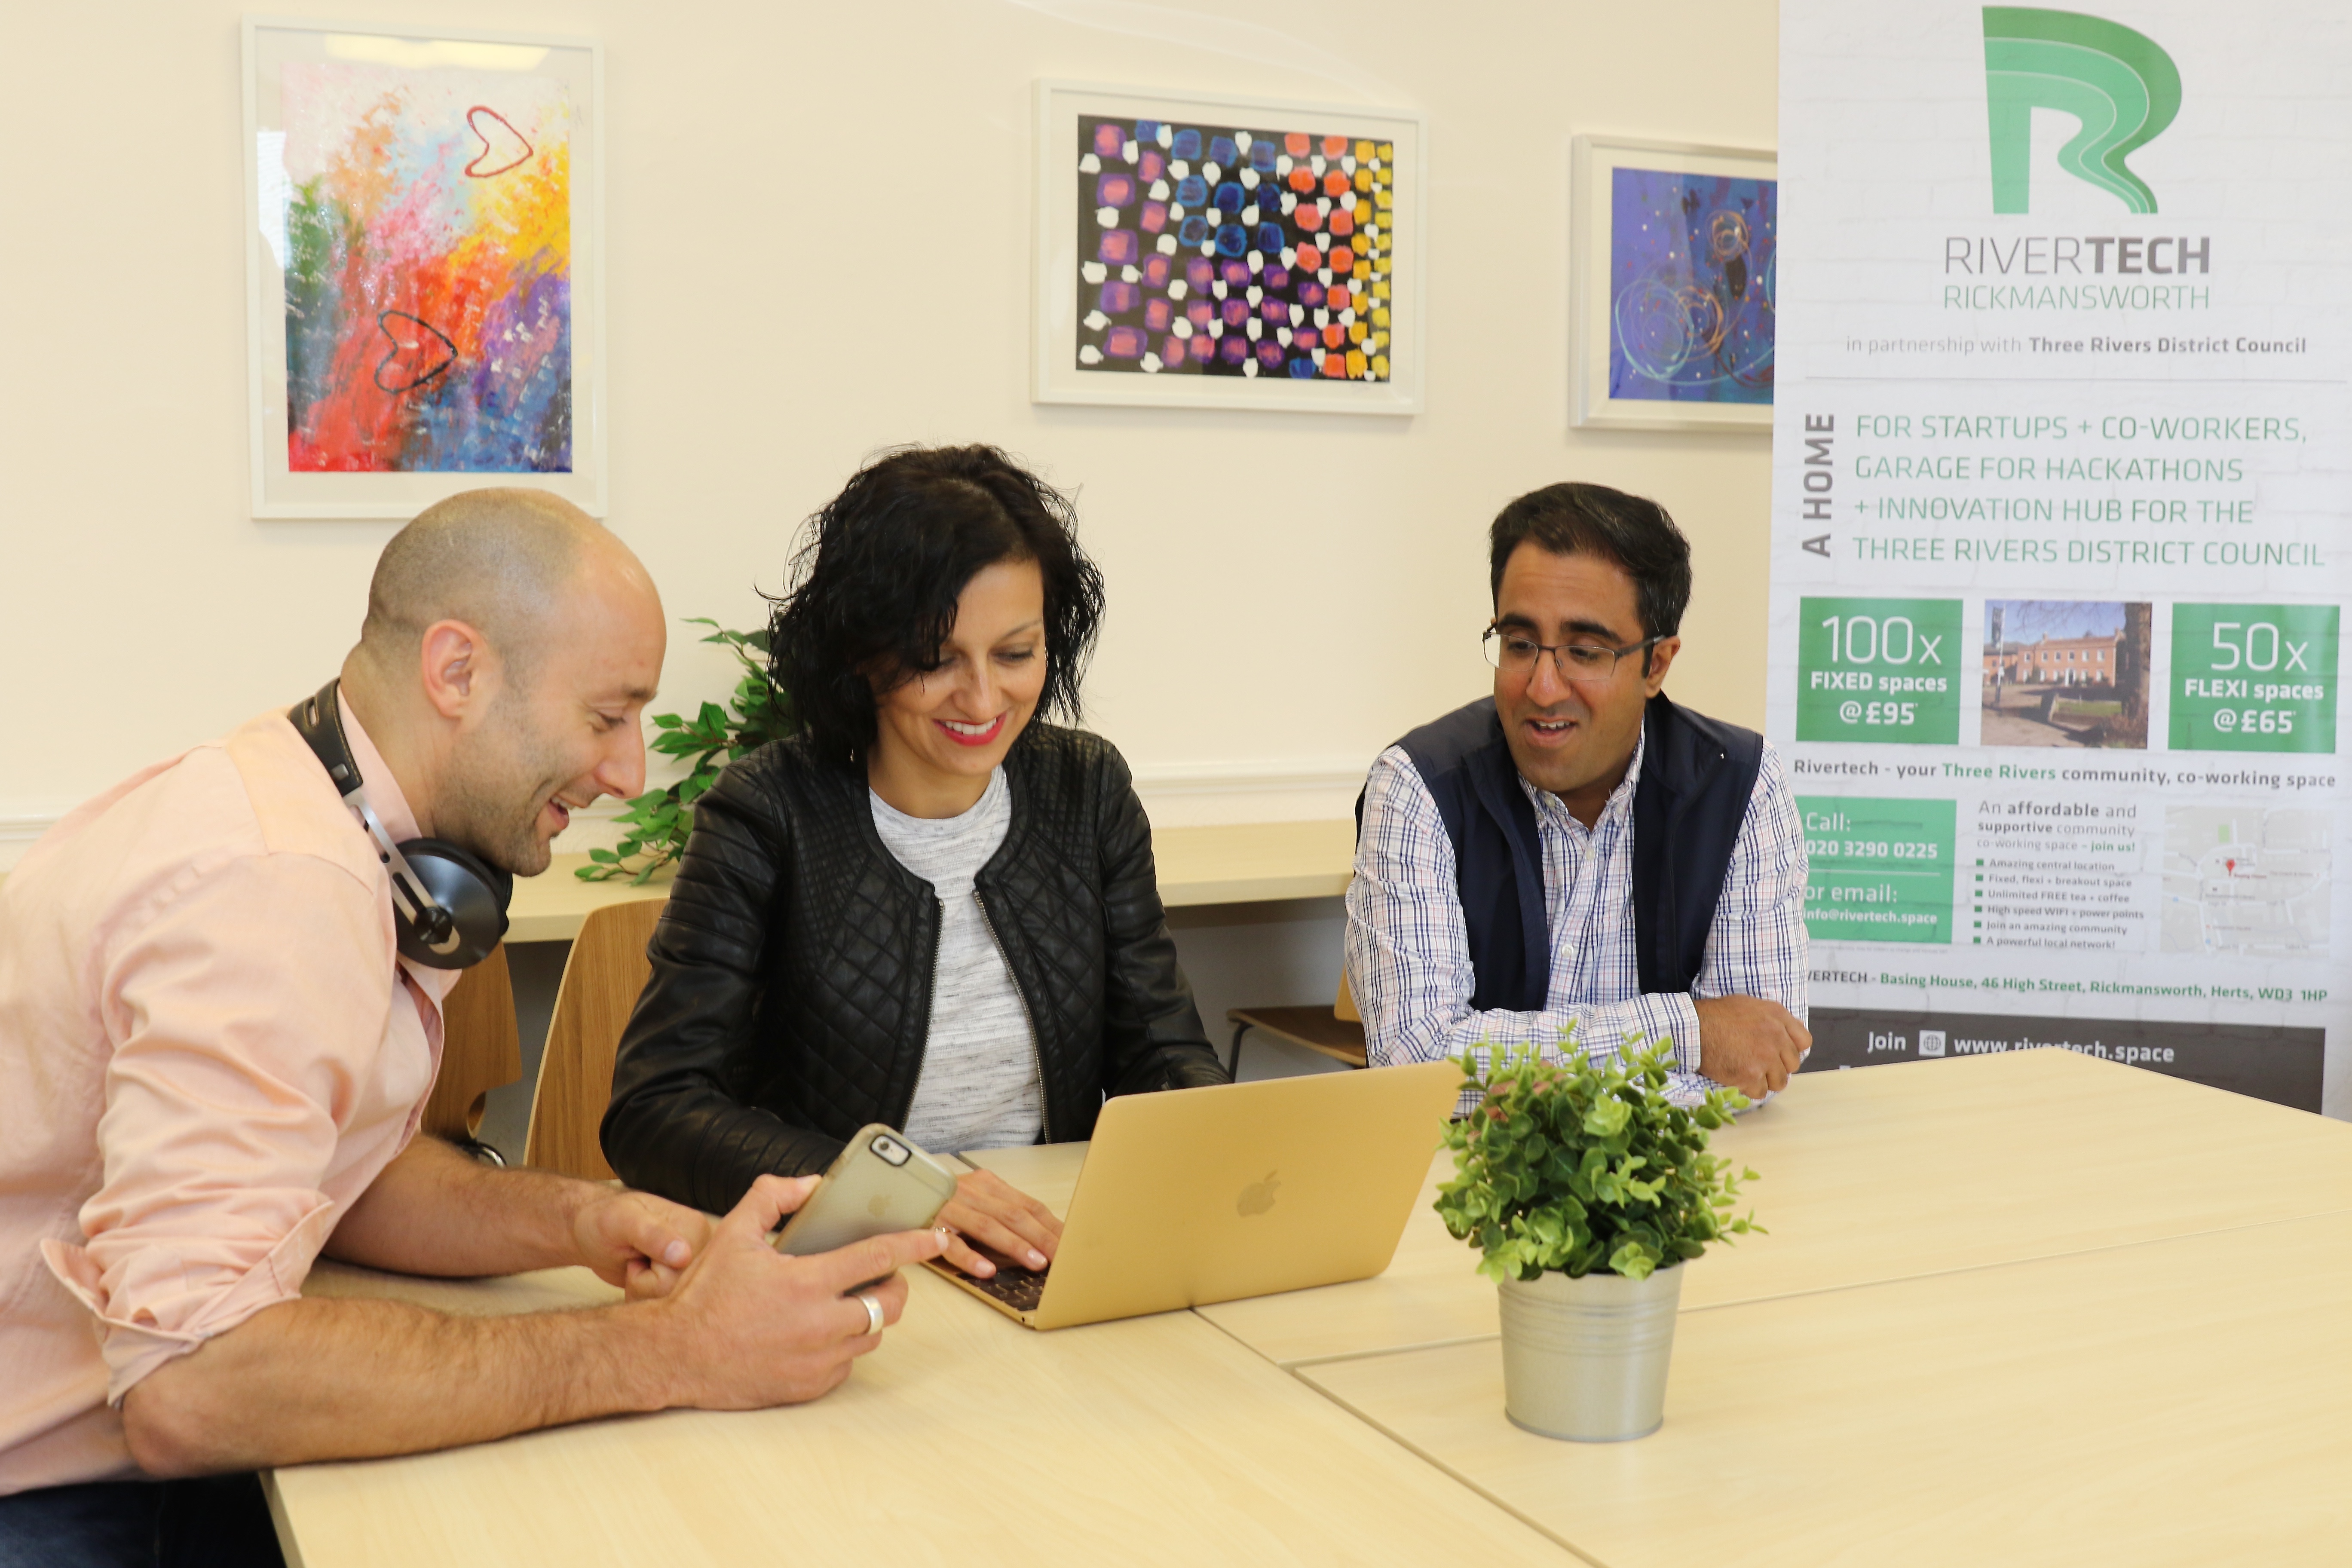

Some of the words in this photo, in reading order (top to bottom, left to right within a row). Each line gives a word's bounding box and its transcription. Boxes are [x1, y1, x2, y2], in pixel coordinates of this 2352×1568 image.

[1946, 237, 2209, 274] RIVERTECH
[1945, 286, 2208, 309] RICKMANSWORTH
[1847, 336, 1862, 352] in
[1869, 337, 1974, 355] partnership
[1981, 337, 2021, 353] with
[2030, 337, 2084, 352] Three
[2092, 337, 2151, 353] Rivers
[2159, 337, 2229, 353] District
[2236, 338, 2306, 353] Council
[1857, 416, 1914, 437] FOR
[1922, 416, 2067, 438] STARTUPS
[2078, 420, 2090, 433] +
[2102, 417, 2306, 443] CO-WORKERS,
[1804, 414, 1834, 519] HOME
[1856, 456, 1970, 478] GARAGE
[1981, 457, 2035, 479] FOR
[2047, 458, 2242, 481] HACKATHONS
[1855, 502, 1868, 514] +
[1879, 498, 2053, 521] INNOVATION
[2064, 499, 2122, 522] HUB
[2133, 500, 2187, 522] FOR
[2197, 501, 2253, 523] THE
[1802, 535, 1830, 557] A
[1852, 537, 1945, 561] THREE
[1955, 540, 2058, 563] RIVERS
[2068, 541, 2193, 564] DISTRICT
[2203, 543, 2325, 566] COUNCIL
[1822, 616, 1941, 665] 100x
[2211, 623, 2308, 672] 50x
[1811, 672, 1872, 691] FIXED
[1878, 674, 1947, 695] spaces
[2185, 679, 2247, 698] FLEXI
[2254, 683, 2324, 703] spaces
[1794, 760, 1878, 774] Rivertech
[1897, 764, 1936, 779] your
[1942, 763, 1992, 778] Three
[2000, 764, 2055, 780] Rivers
[2062, 766, 2171, 785] community,
[2177, 771, 2280, 789] co-working
[2287, 775, 2335, 789] space
[1979, 801, 2001, 815] An
[2008, 801, 2098, 816] affordable
[2106, 805, 2136, 818] and
[1806, 812, 1851, 831] Call:
[1978, 821, 2052, 834] supportive
[2057, 824, 2135, 838] community
[1806, 840, 1838, 855] 020
[1844, 841, 1888, 857] 3290
[1893, 842, 1938, 858] 0225
[1977, 839, 2041, 851] co-working
[2045, 842, 2077, 851] space
[2091, 841, 2113, 852] join
[2118, 842, 2135, 852] us!
[1989, 859, 2034, 870] Amazing
[2037, 861, 2070, 870] central
[2074, 861, 2114, 871] location
[1989, 874, 2018, 884] Fixed,
[2022, 874, 2043, 884] flexi
[2056, 876, 2100, 886] breakout
[2104, 879, 2132, 888] space
[1805, 885, 1825, 900] or
[1831, 884, 1897, 902] email:
[1989, 890, 2038, 900] Unlimited
[2042, 891, 2067, 900] FREE
[2098, 894, 2129, 903] coffee
[1803, 908, 1938, 925] info@rivertech.space
[1988, 905, 2010, 916] High
[2013, 906, 2042, 917] speed
[2080, 910, 2110, 919] power
[2113, 909, 2144, 919] points
[1987, 921, 2006, 930] Join
[2024, 922, 2068, 934] amazing
[2070, 924, 2127, 935] community
[1987, 937, 1994, 945] A
[1997, 936, 2041, 948] powerful
[2044, 937, 2067, 947] local
[2071, 939, 2115, 949] network!
[1808, 970, 1867, 983] VERTECH
[1881, 973, 1925, 988] Basing
[1930, 976, 1976, 989] House,
[1981, 978, 1999, 989] 46
[2003, 978, 2035, 993] High
[2039, 979, 2086, 994] Street,
[2090, 981, 2206, 998] Rickmansworth,
[2211, 986, 2253, 1001] Herts,
[2258, 988, 2292, 1000] WD3
[2301, 989, 2327, 1001] 1HP
[1868, 1032, 1905, 1053] Join
